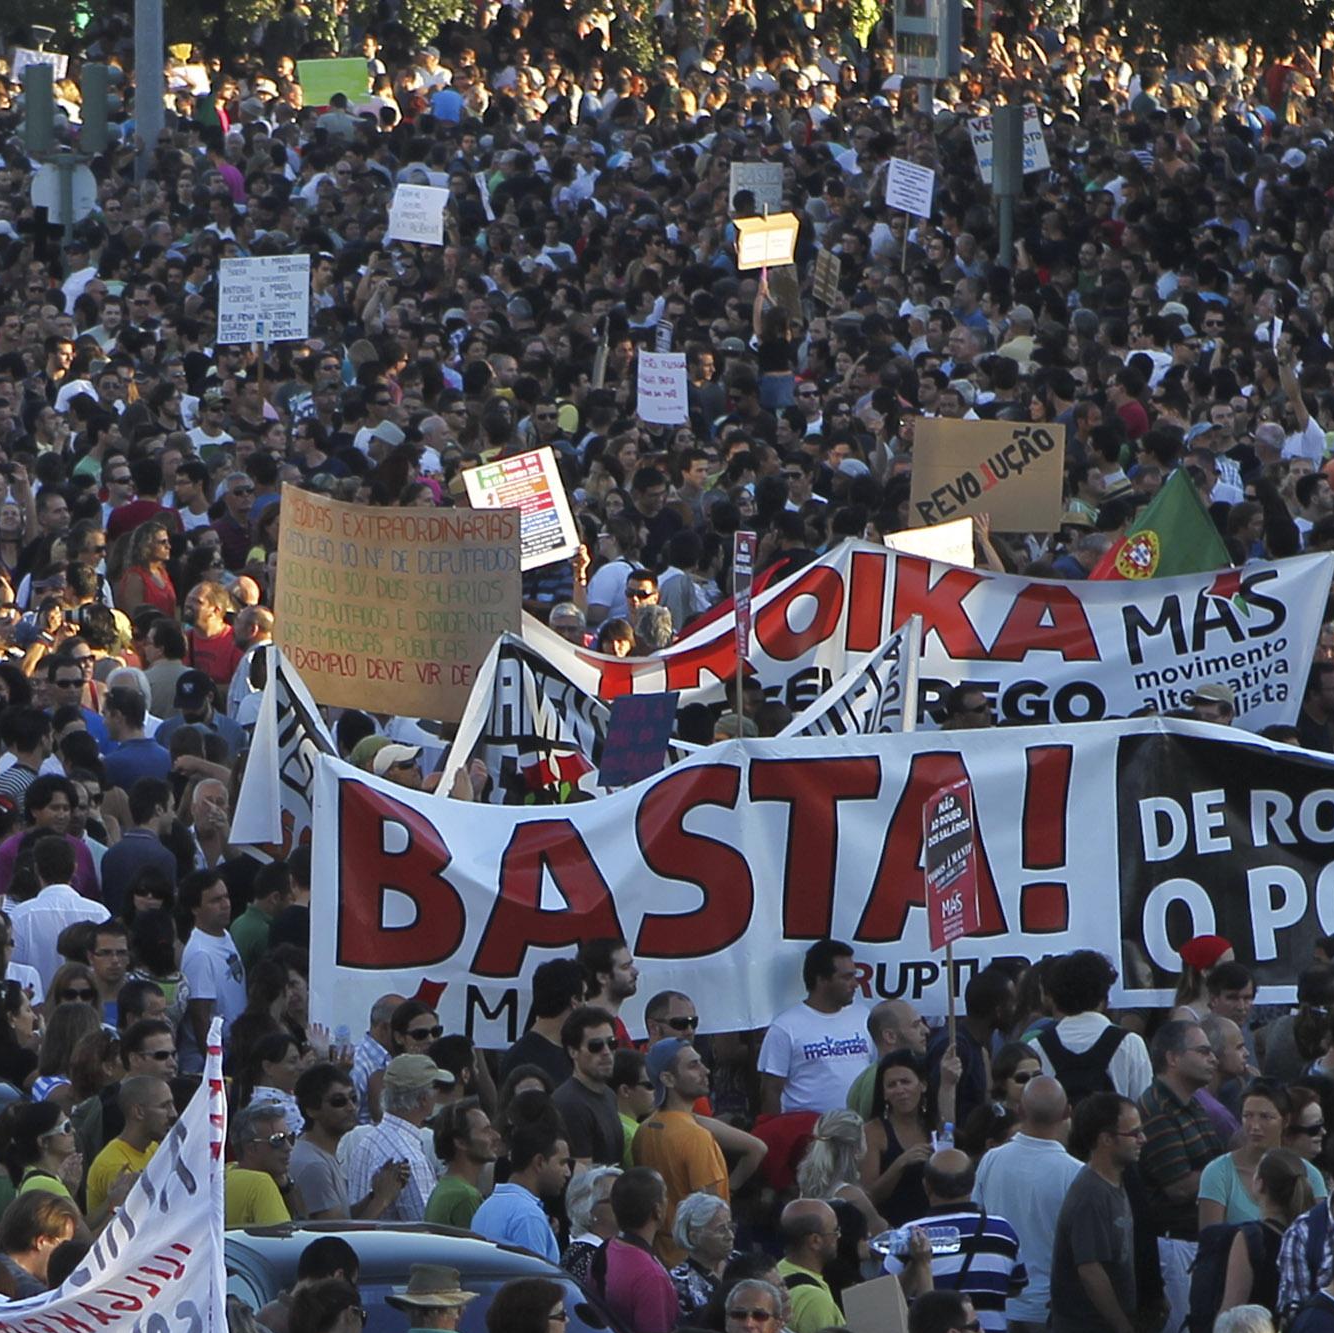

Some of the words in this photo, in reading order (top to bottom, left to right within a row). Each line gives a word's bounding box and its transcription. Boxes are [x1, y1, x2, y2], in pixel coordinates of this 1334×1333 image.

[916, 426, 1055, 526] REVOLUÇÃO
[391, 550, 408, 574] DE
[418, 548, 516, 575] DEPUTADOS
[376, 575, 408, 601] DOS
[309, 599, 390, 628] DEPUTADOS
[396, 608, 408, 632] E
[415, 610, 513, 635] DIRIGENTES
[309, 625, 383, 656] EMPRESAS
[295, 646, 358, 678] EXEMPLO
[367, 658, 405, 683] DEVE
[416, 662, 442, 686] VIR
[451, 664, 472, 687] DE
[1134, 637, 1288, 690] movimento
[1143, 659, 1289, 712] alteativa
[931, 819, 939, 831] AO
[939, 808, 962, 828] ROUBO
[938, 796, 954, 814] NÃO
[928, 834, 939, 847] DOS
[939, 818, 970, 843] SALÁRIOS
[1139, 788, 1232, 862] DE
[336, 744, 1073, 979] BASTA!
[1142, 878, 1216, 975] O
